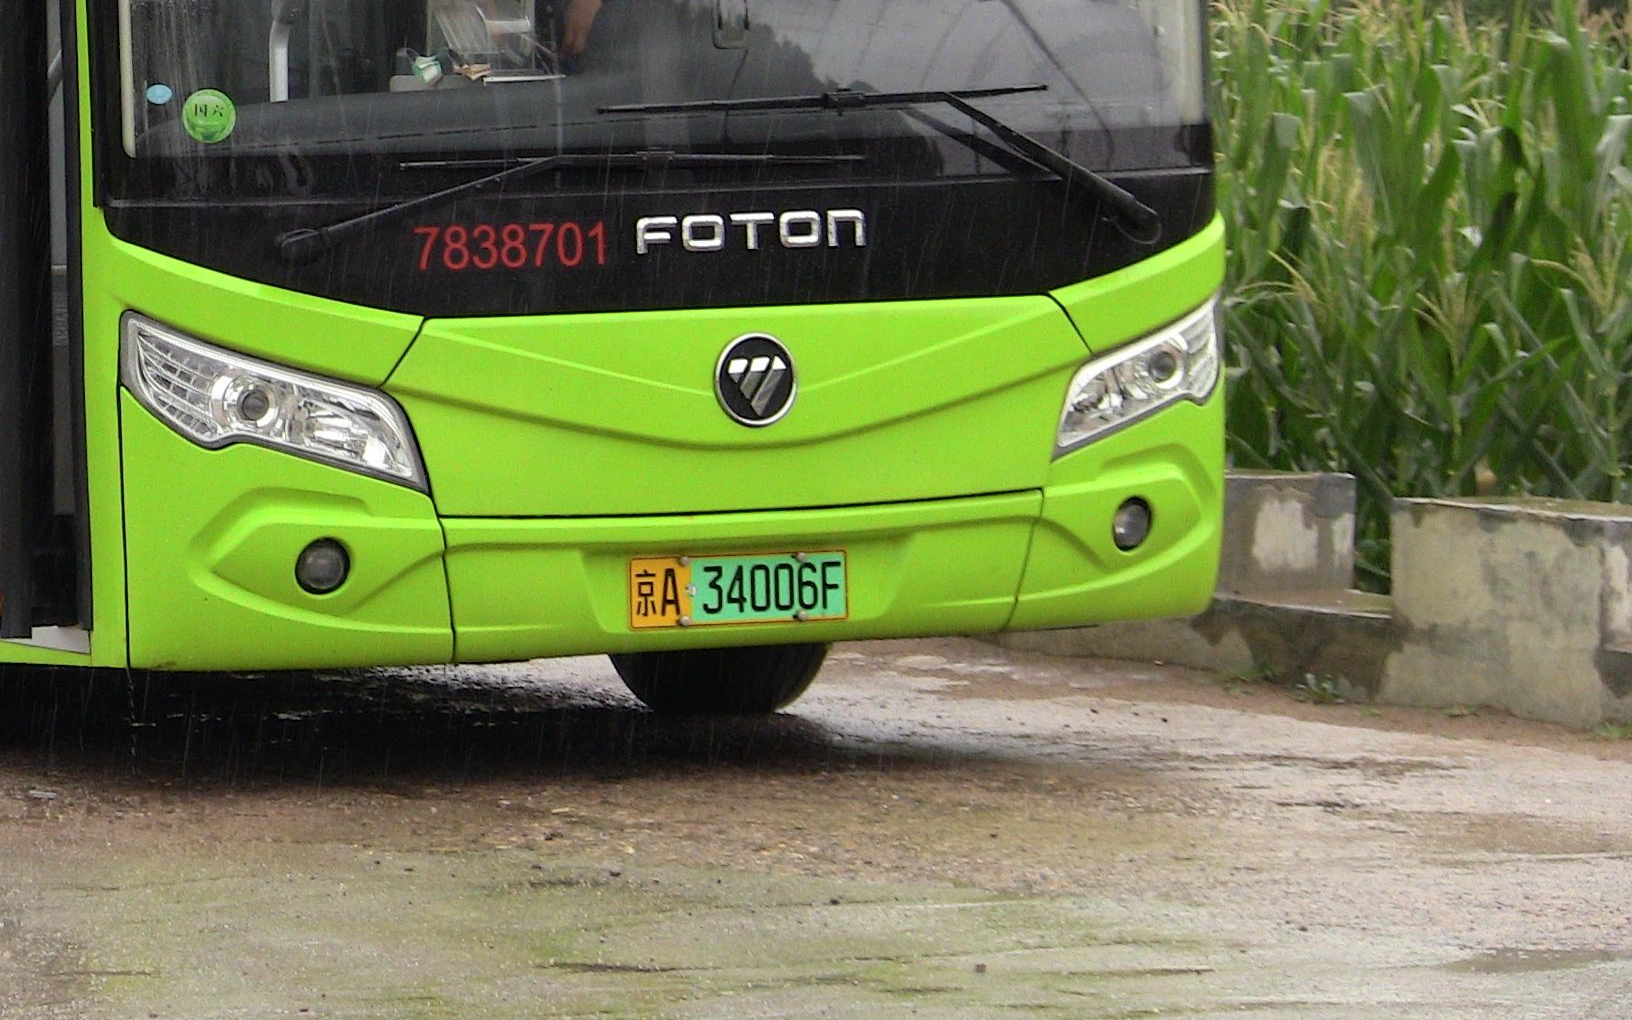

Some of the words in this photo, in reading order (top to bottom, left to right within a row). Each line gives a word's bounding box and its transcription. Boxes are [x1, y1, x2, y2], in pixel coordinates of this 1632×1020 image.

[414, 222, 607, 270] 7838701
[636, 209, 867, 255] FOTON
[635, 568, 681, 617] 京A
[702, 561, 842, 614] 34006F
